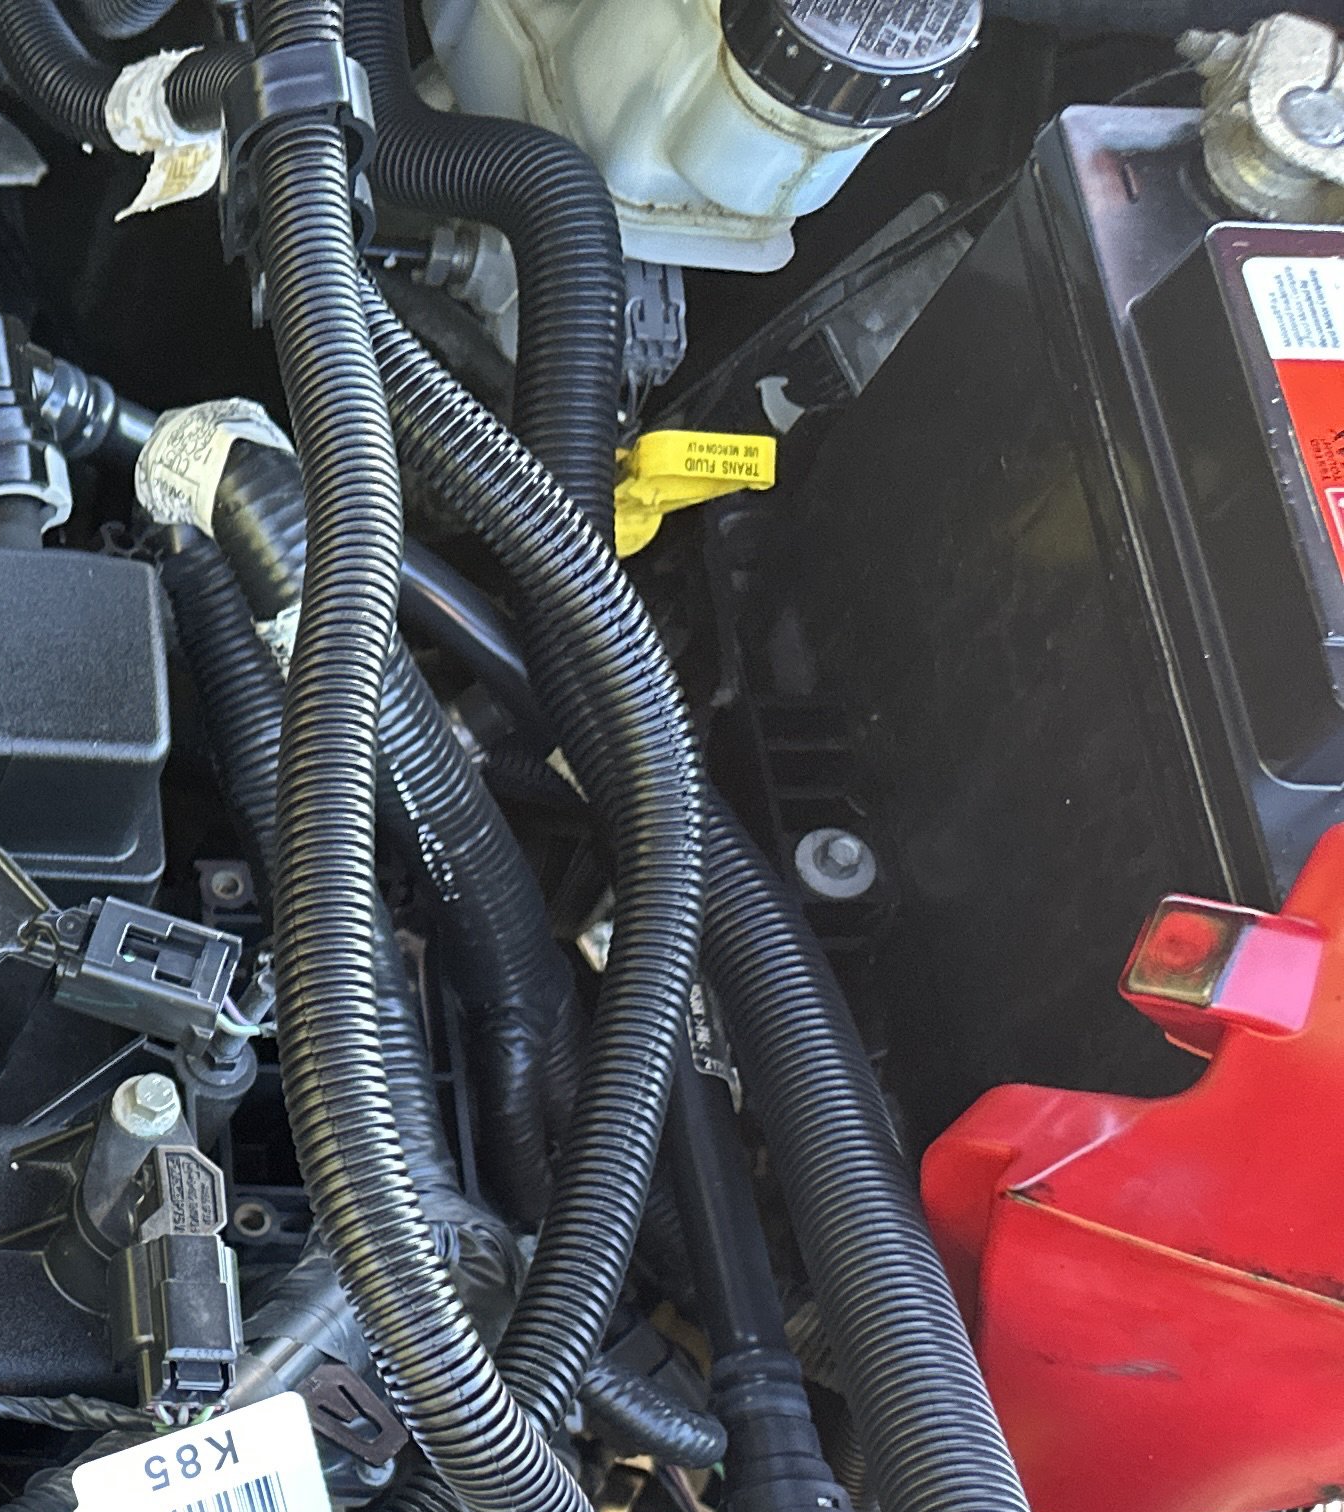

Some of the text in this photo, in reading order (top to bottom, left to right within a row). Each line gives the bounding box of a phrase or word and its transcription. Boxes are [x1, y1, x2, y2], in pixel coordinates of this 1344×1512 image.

[684, 458, 759, 477] TRANS FLUID
[143, 1429, 240, 1492] K85
